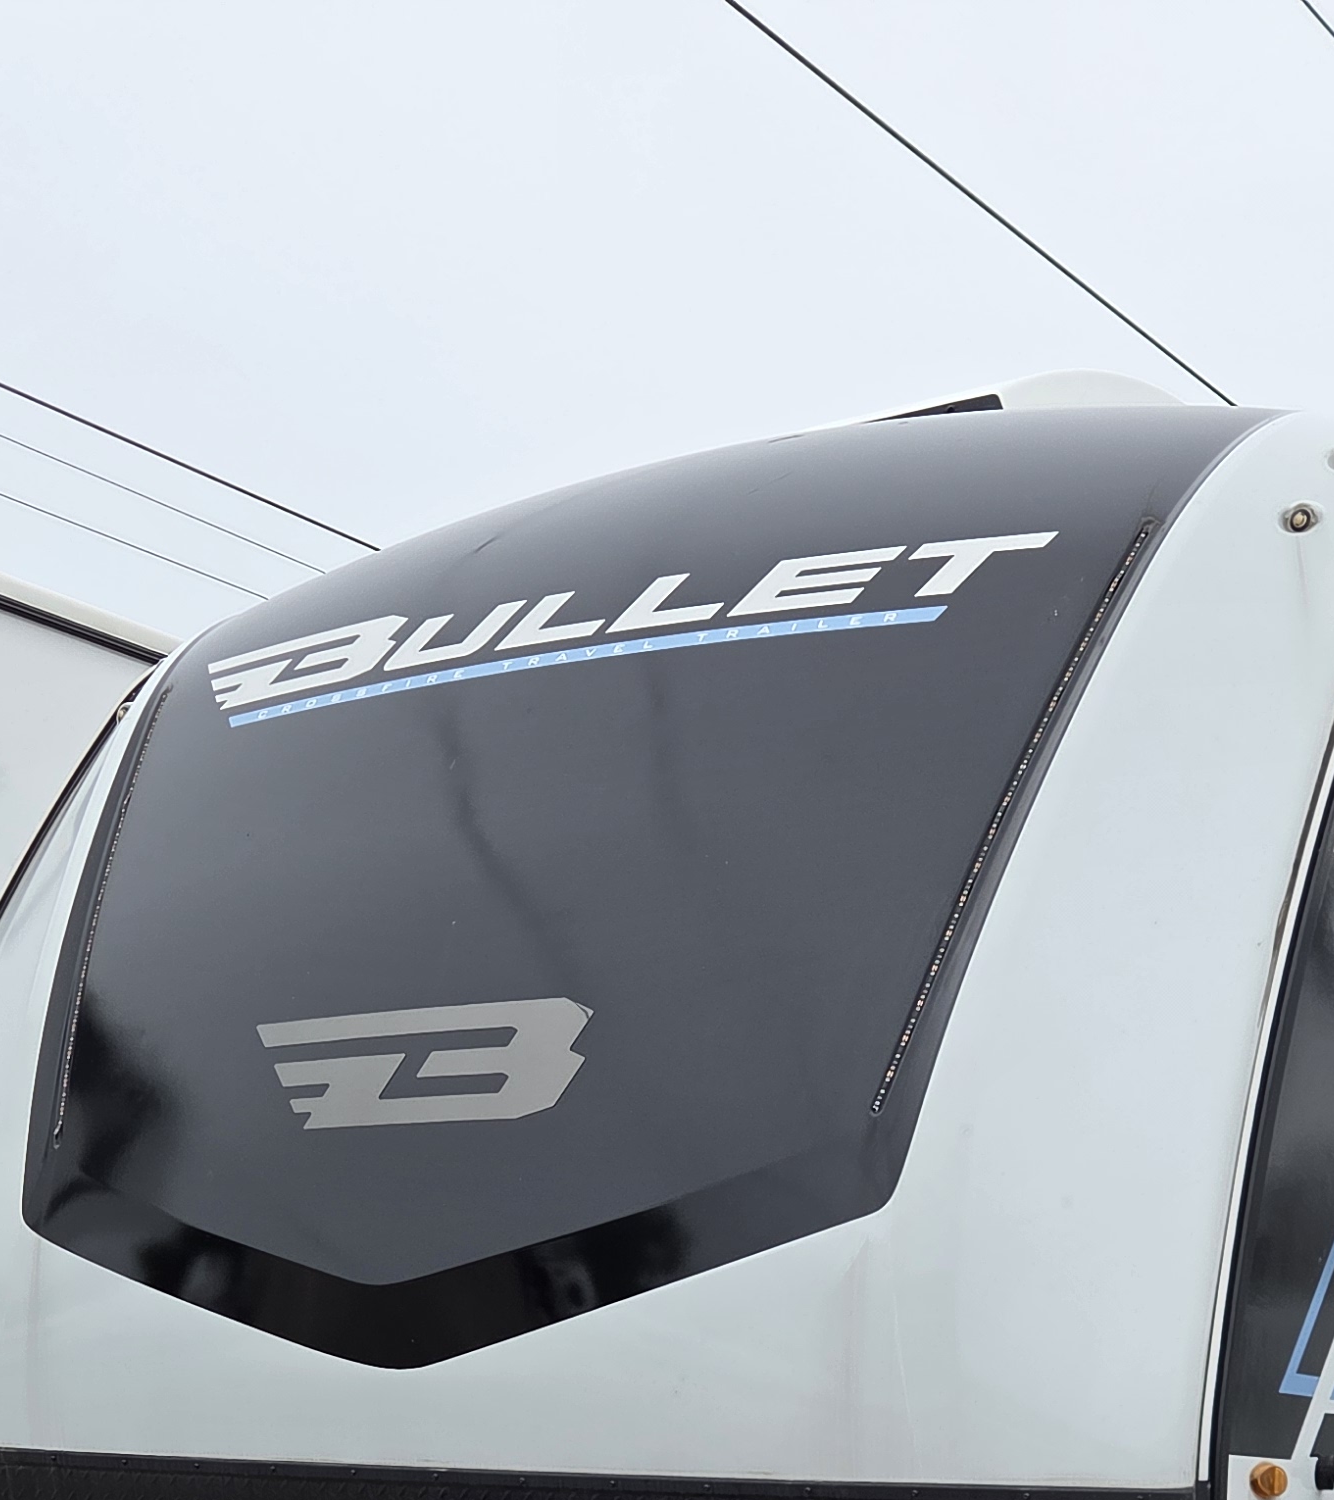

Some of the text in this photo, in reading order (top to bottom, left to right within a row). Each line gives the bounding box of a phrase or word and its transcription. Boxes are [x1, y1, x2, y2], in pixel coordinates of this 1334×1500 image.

[208, 531, 1059, 710] BULLET
[257, 612, 900, 719] CROSSFIRE TRAVEL TRAILER
